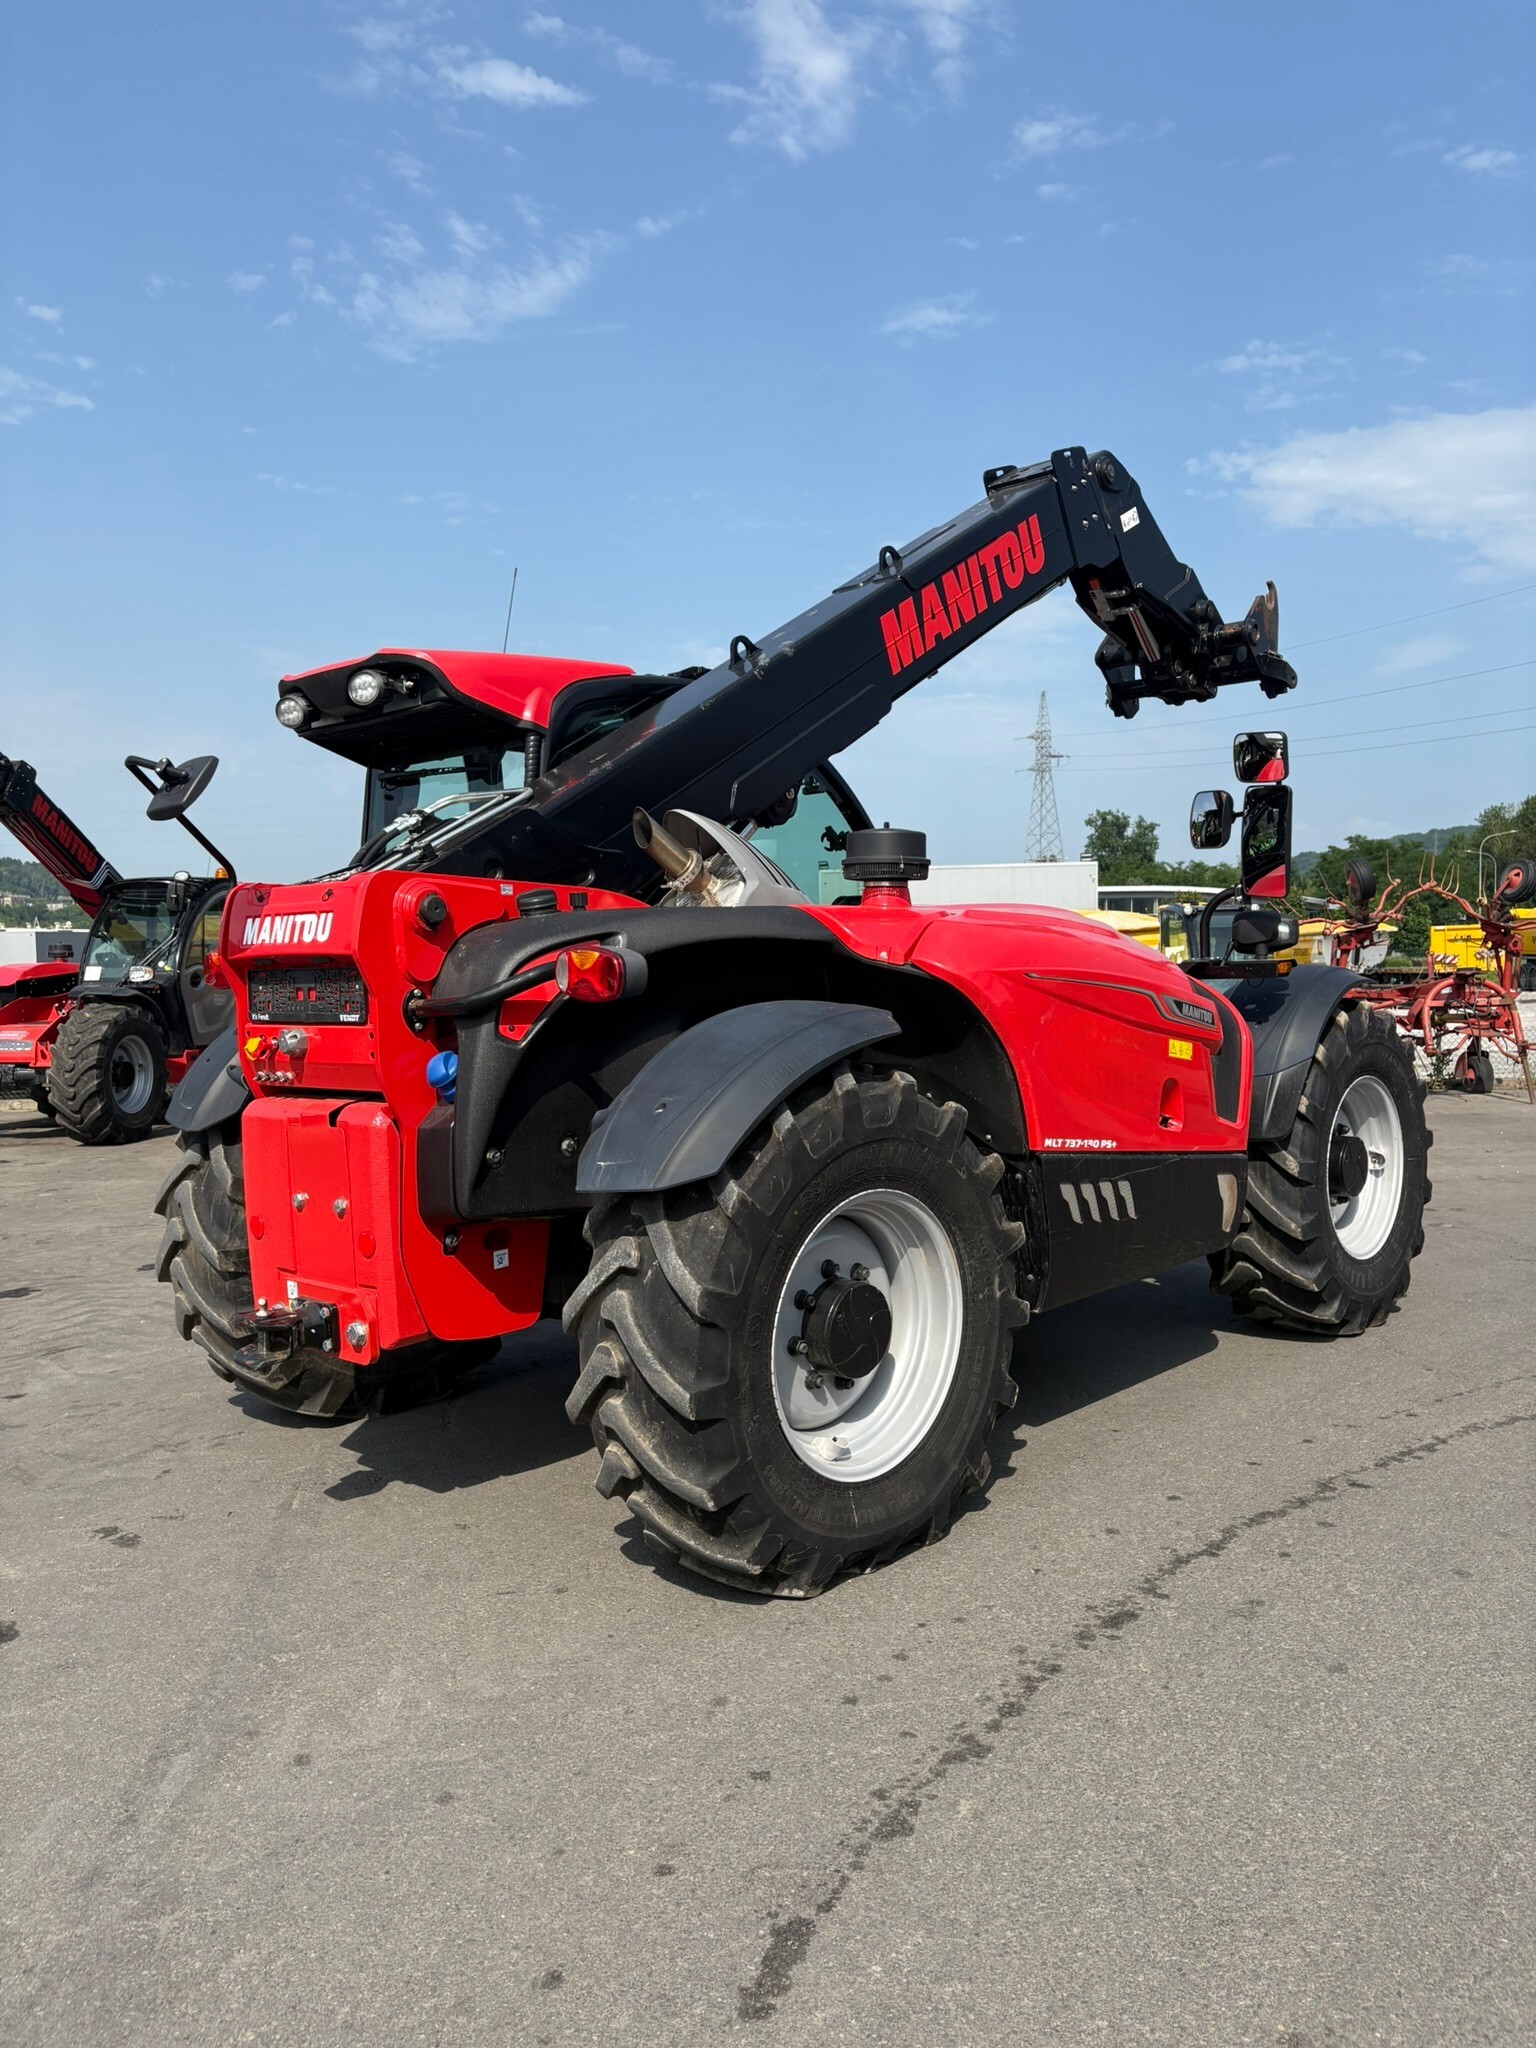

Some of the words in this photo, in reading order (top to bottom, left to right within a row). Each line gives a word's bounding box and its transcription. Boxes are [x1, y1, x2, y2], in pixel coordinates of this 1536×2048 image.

[879, 513, 1046, 676] MANITOU
[31, 793, 98, 873] MANITOU
[243, 912, 333, 945] MANITOU
[1182, 1002, 1213, 1024] MANITOU
[1044, 1138, 1063, 1148] MLT
